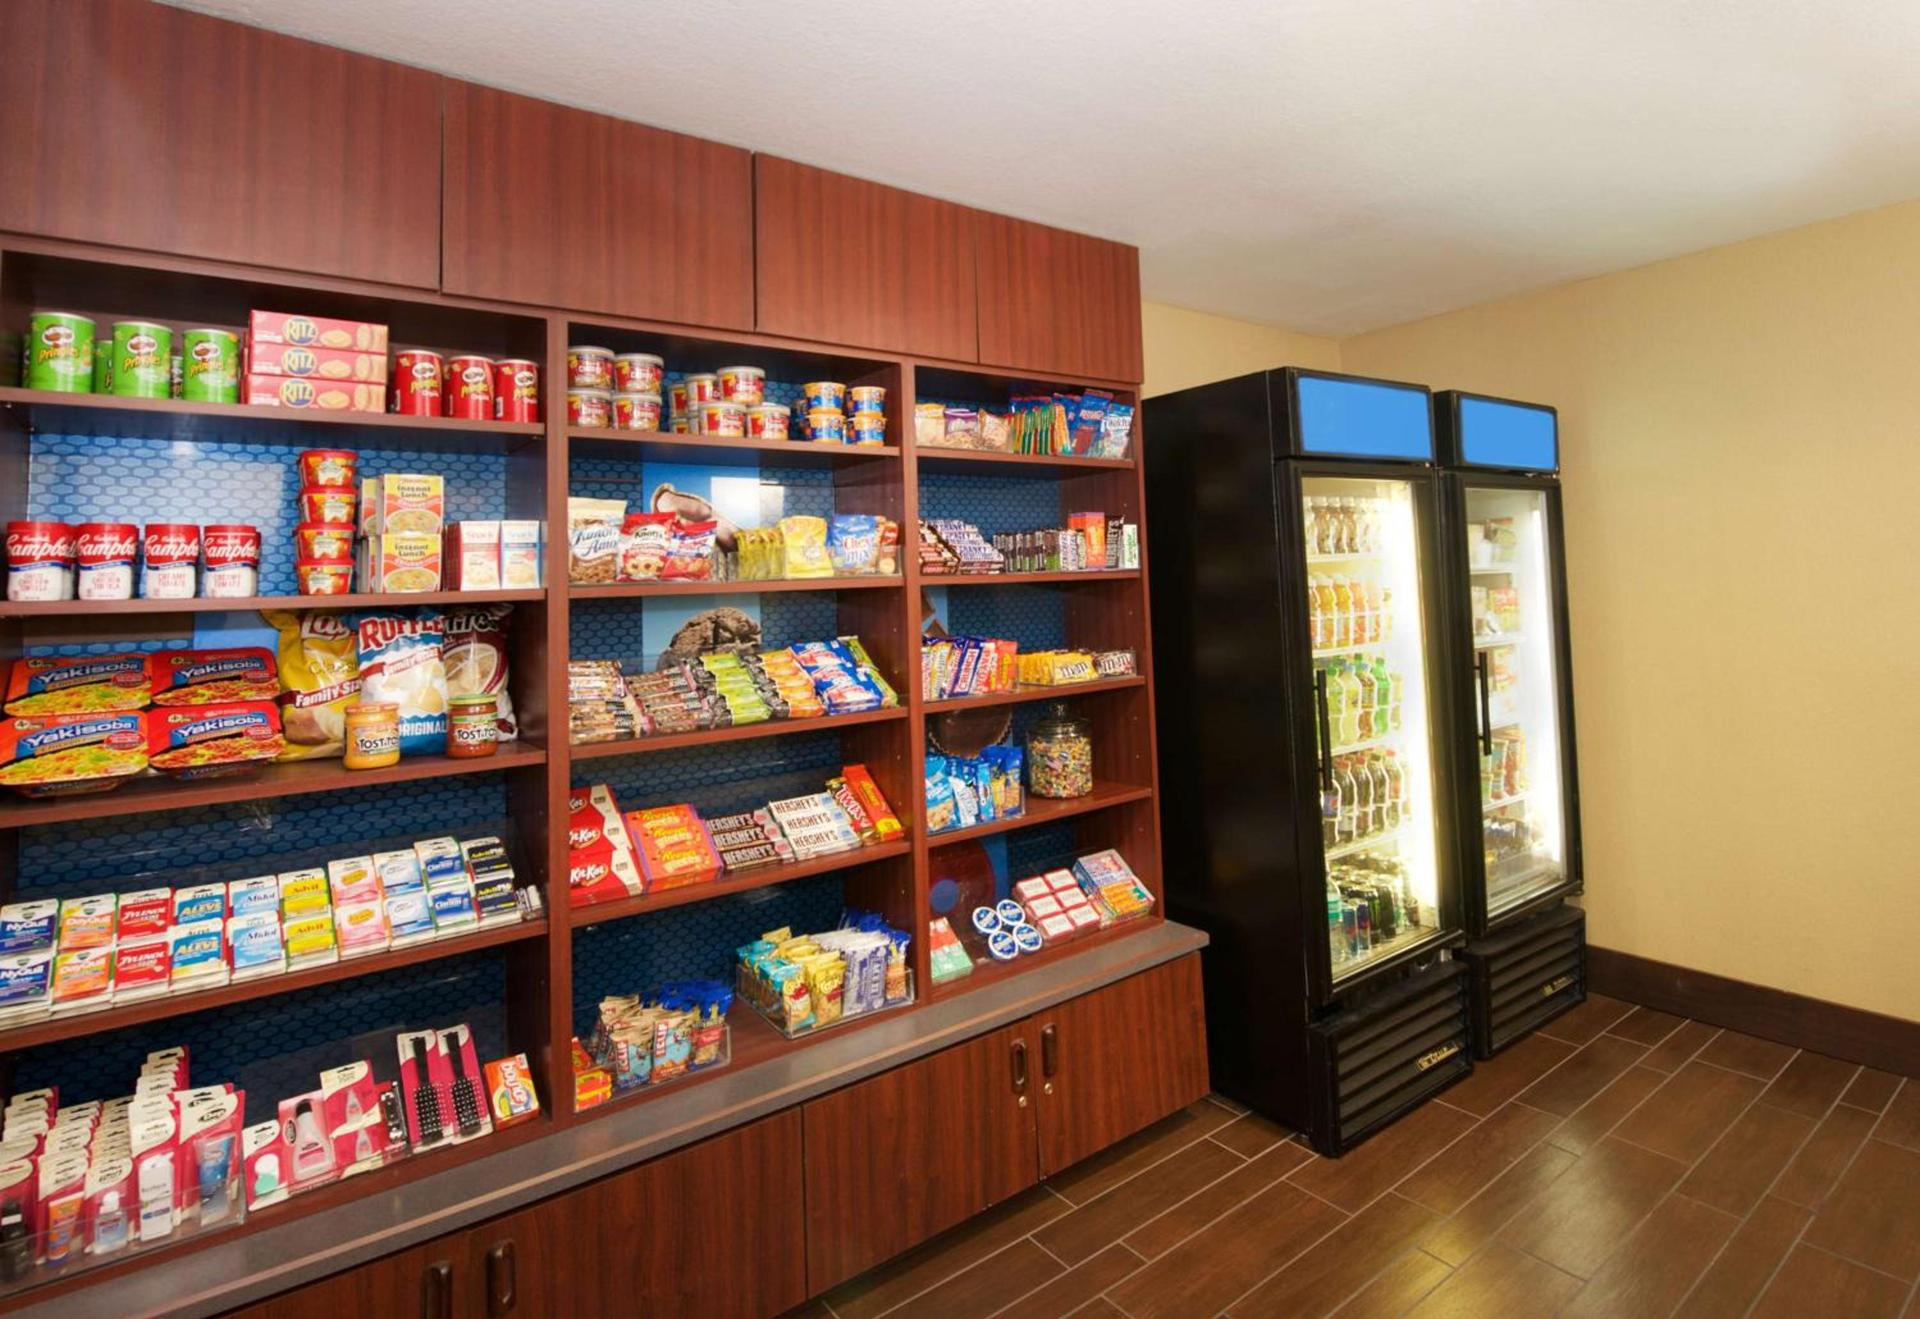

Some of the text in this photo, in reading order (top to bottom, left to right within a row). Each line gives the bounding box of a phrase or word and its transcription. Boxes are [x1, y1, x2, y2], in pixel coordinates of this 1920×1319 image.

[39, 661, 138, 684] Yakisoba
[181, 661, 261, 678] Yakisoba
[296, 685, 340, 708] Family
[26, 721, 133, 747] Yakisoba
[178, 716, 265, 737] Yakisoba
[774, 797, 820, 814] HERSHEY'S
[787, 813, 832, 830] HERSHEY'S
[714, 828, 765, 847] HERSHEY'S
[793, 829, 838, 848] HERSHEY'S
[723, 845, 777, 865] HERSHEY'S
